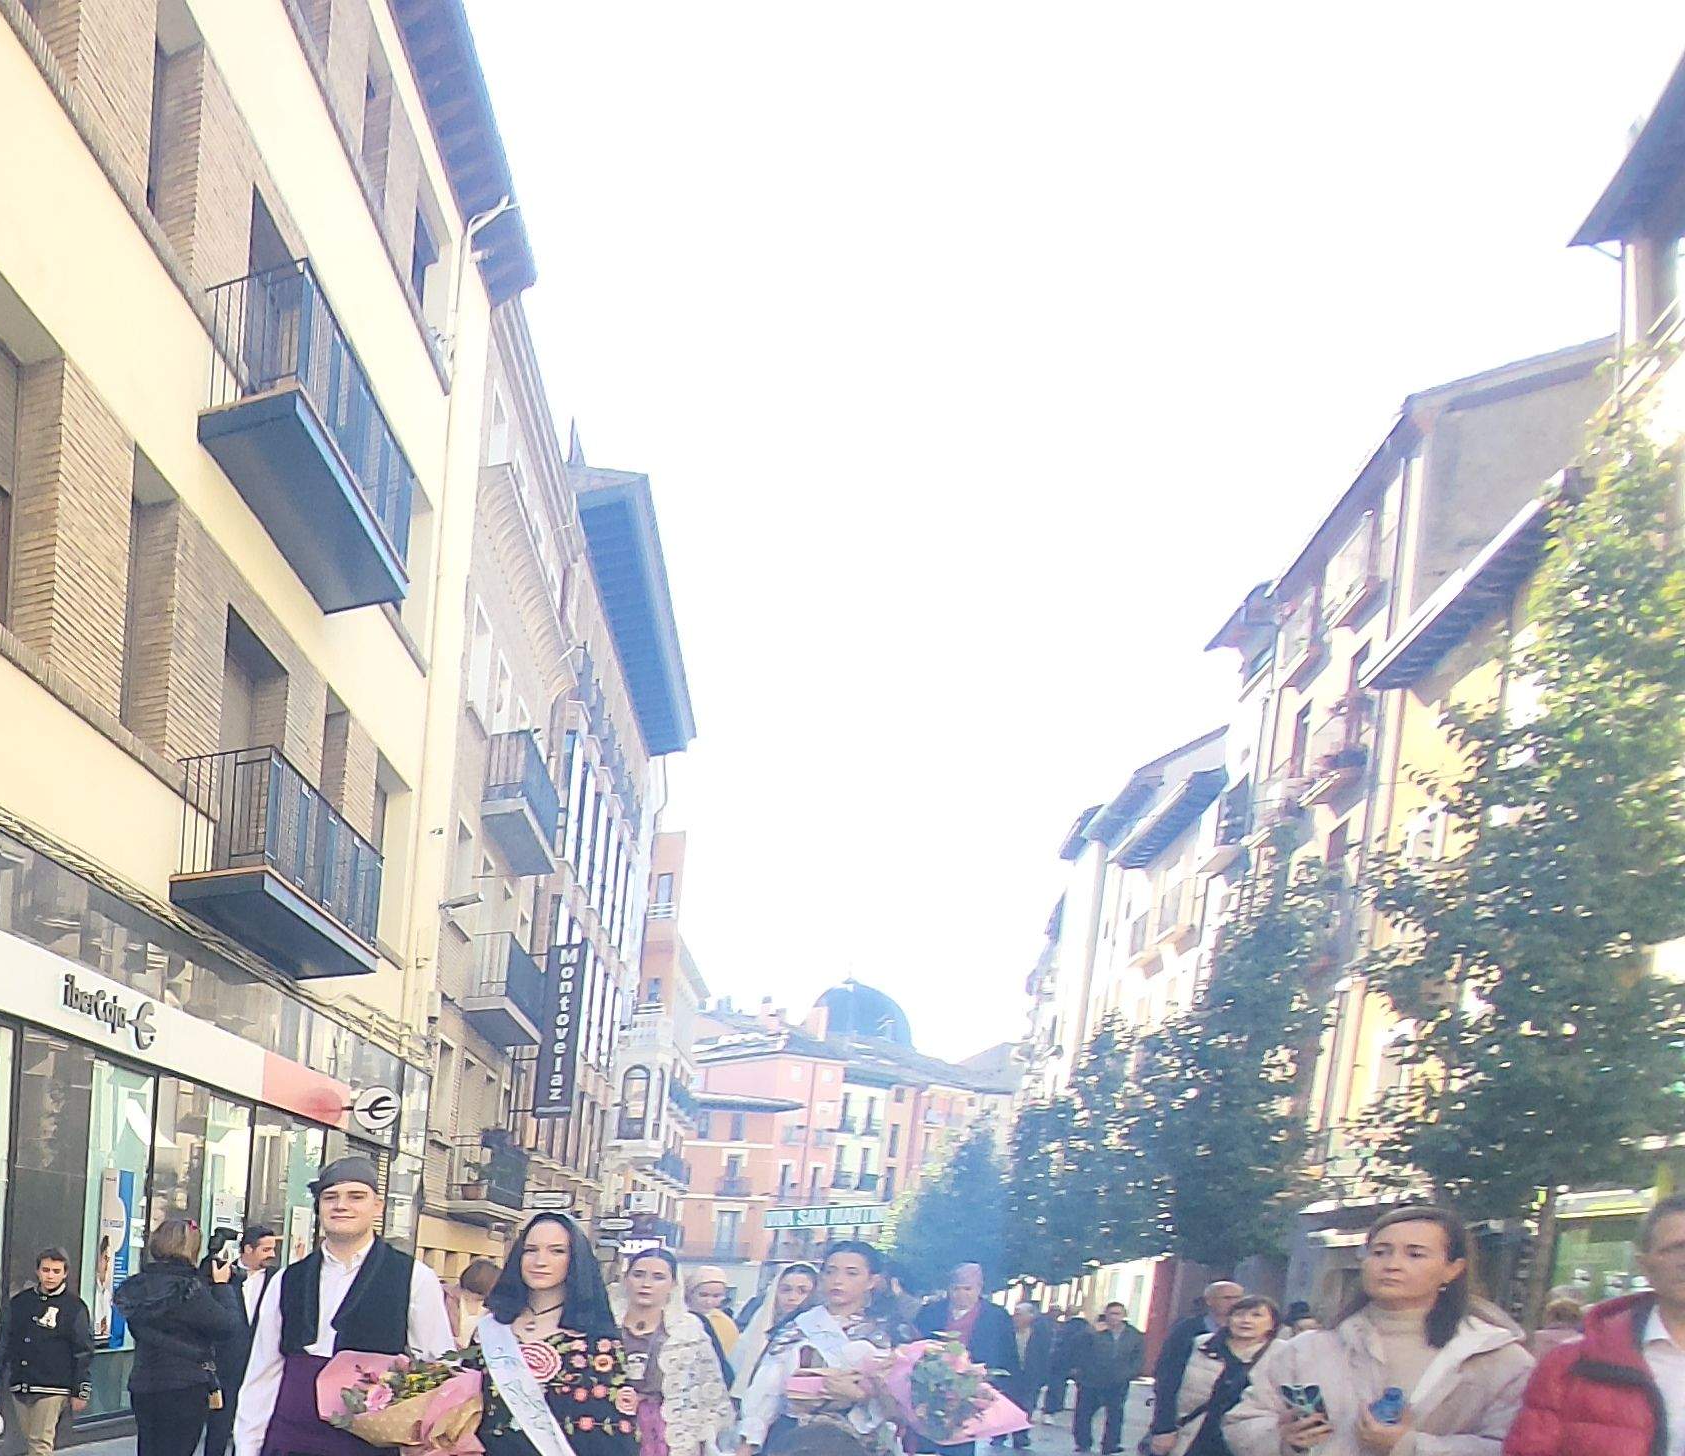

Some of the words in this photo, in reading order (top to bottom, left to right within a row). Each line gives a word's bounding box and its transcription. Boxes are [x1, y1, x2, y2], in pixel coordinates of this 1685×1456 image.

[63, 973, 127, 1034] iberCaja
[548, 948, 579, 1100] Montovelaz
[37, 1306, 60, 1330] A
